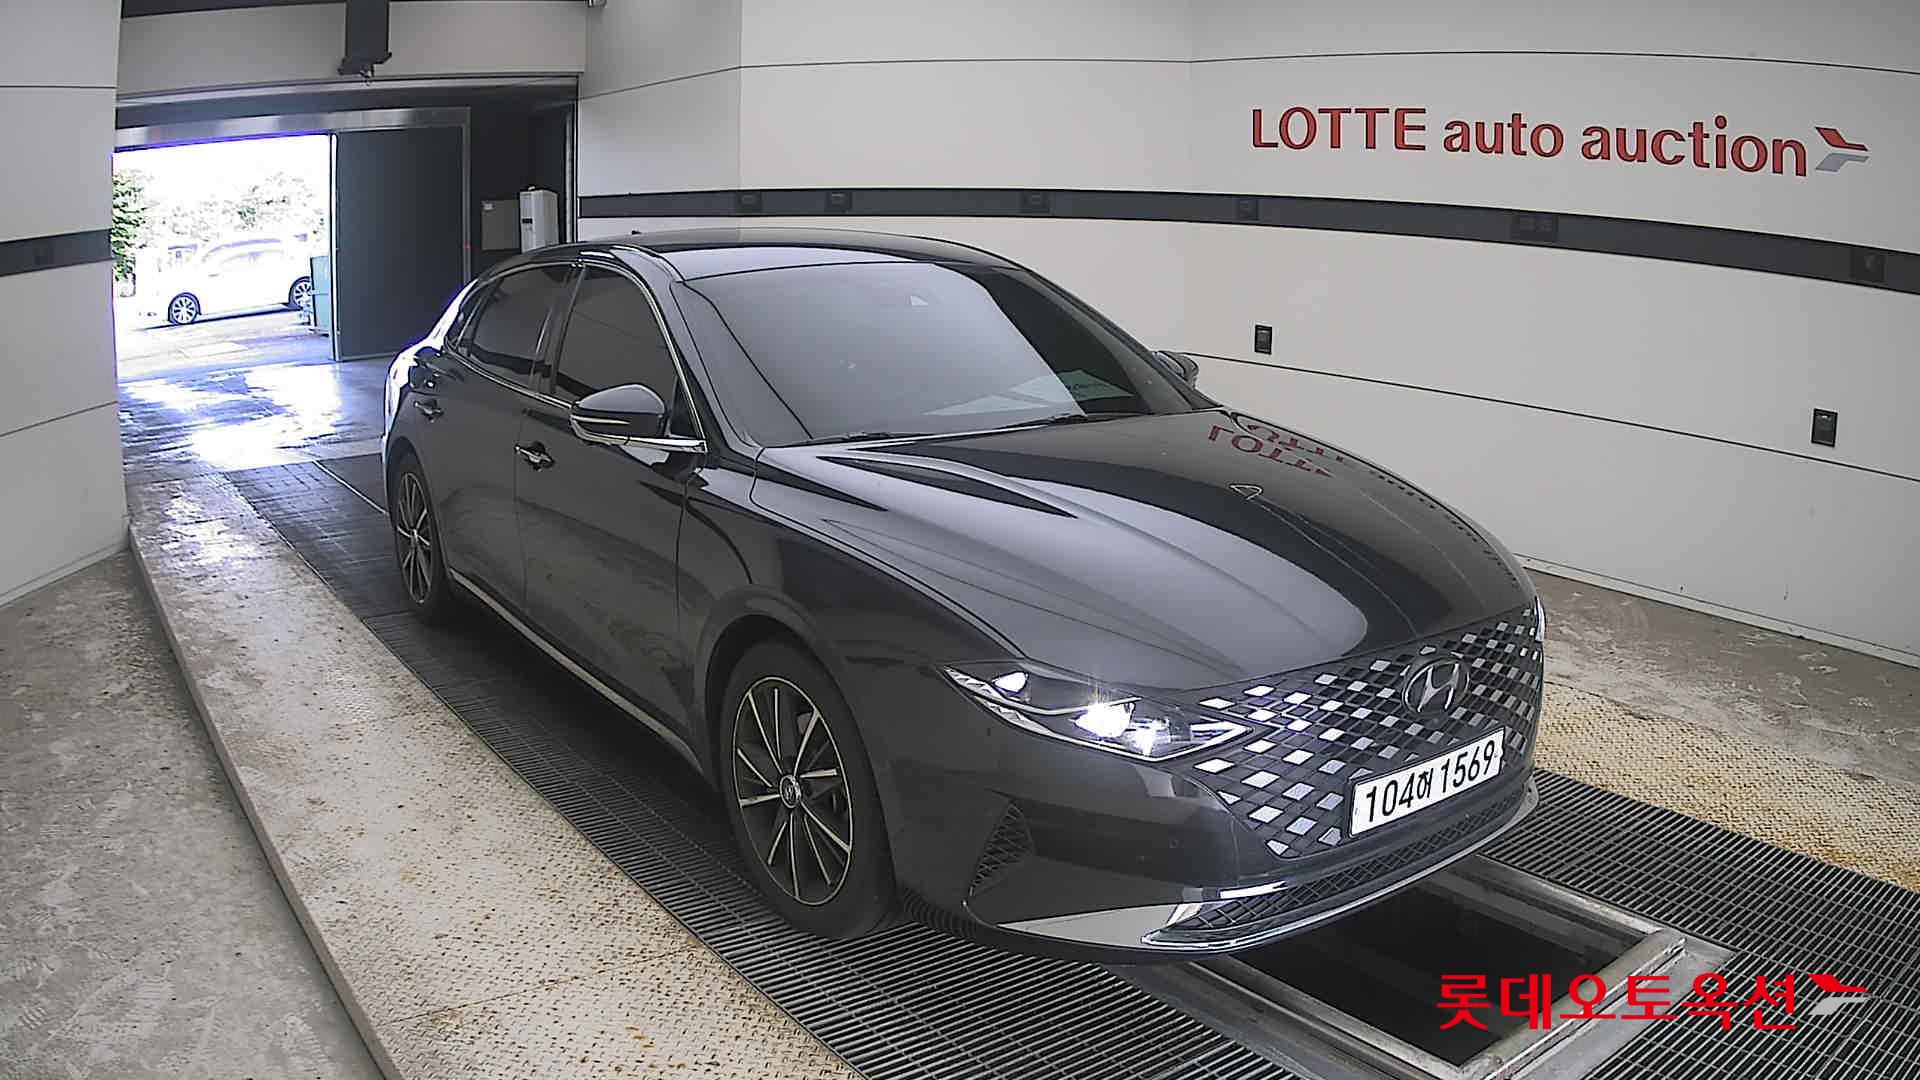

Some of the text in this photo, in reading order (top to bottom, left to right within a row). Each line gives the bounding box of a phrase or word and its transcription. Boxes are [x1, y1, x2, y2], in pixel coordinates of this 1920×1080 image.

[1252, 107, 1807, 177] LOTTE auto auction
[1440, 739, 1496, 794] 1569
